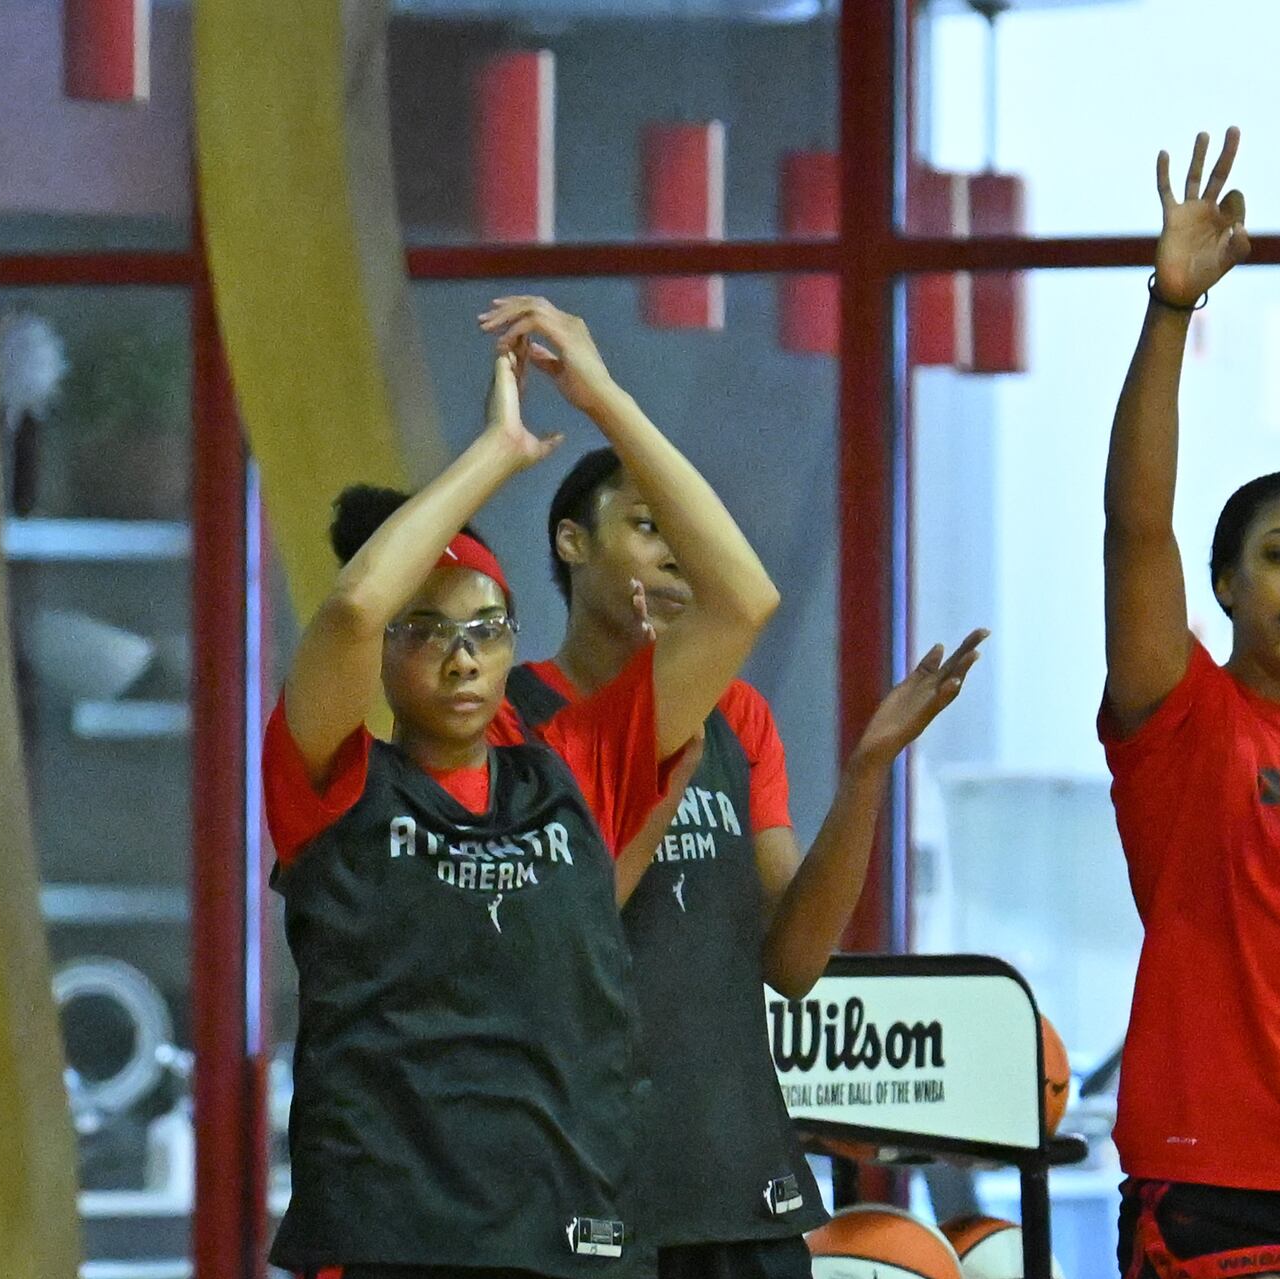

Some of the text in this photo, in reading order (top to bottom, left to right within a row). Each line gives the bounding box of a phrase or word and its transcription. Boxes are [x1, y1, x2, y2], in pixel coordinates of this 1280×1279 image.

[389, 815, 574, 867] ATANTA
[437, 861, 539, 891] DREAM
[769, 996, 946, 1073] Wilson
[816, 1081, 846, 1107] GAME
[848, 1080, 873, 1106] BALL
[875, 1080, 889, 1105] OF
[890, 1079, 910, 1104] THE
[913, 1078, 946, 1103] WNBA
